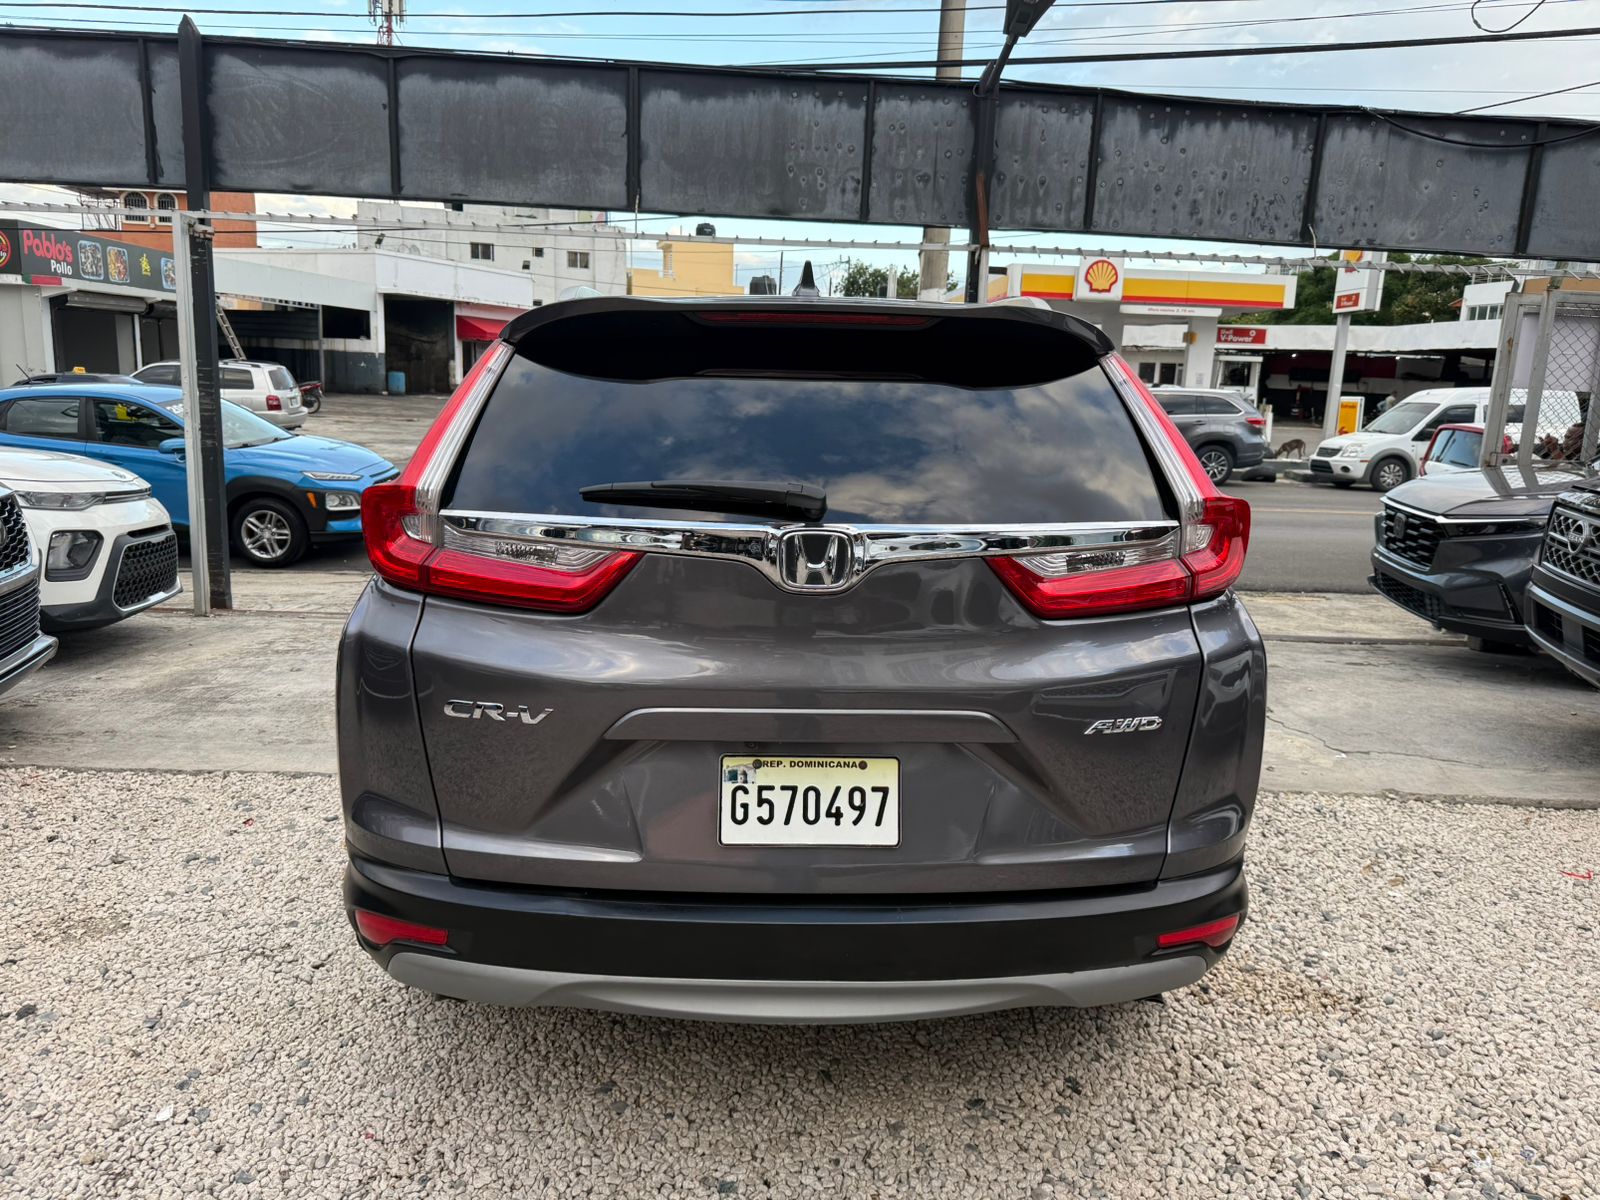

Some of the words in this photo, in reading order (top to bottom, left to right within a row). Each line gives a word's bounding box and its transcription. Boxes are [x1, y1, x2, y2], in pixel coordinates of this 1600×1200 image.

[23, 229, 73, 263] Pablo's
[50, 259, 73, 275] Pollo
[1220, 335, 1254, 343] V-Power
[443, 699, 554, 724] CR-V
[1083, 716, 1163, 735] AWD
[762, 760, 786, 769] REP.
[789, 760, 858, 769] DOMINICANA
[730, 784, 890, 827] G570497
